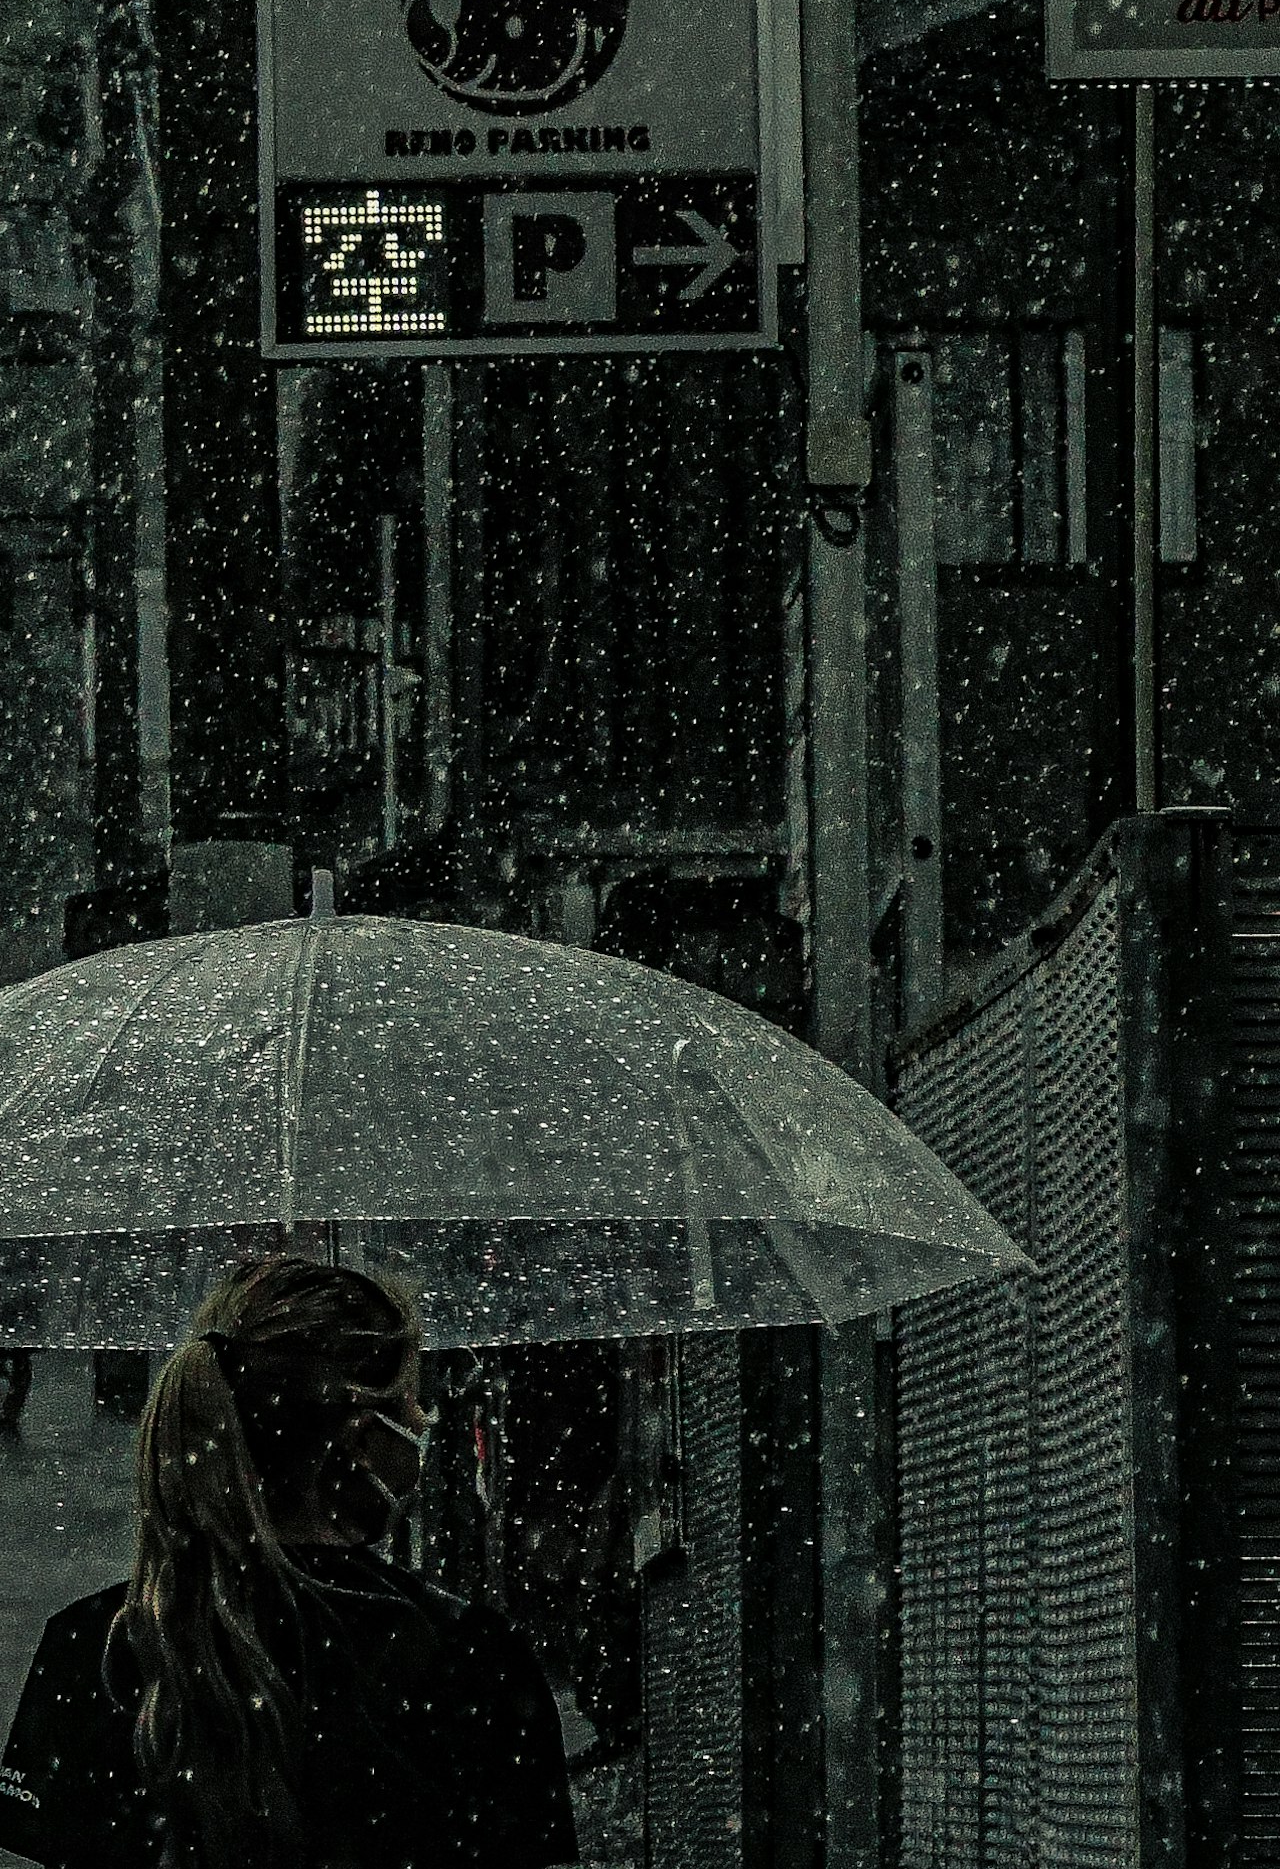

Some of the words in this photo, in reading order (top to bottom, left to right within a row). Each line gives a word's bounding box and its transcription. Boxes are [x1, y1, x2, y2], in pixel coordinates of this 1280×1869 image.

[488, 126, 650, 153] PARKING
[304, 189, 445, 332] 空
[513, 214, 586, 301] P
